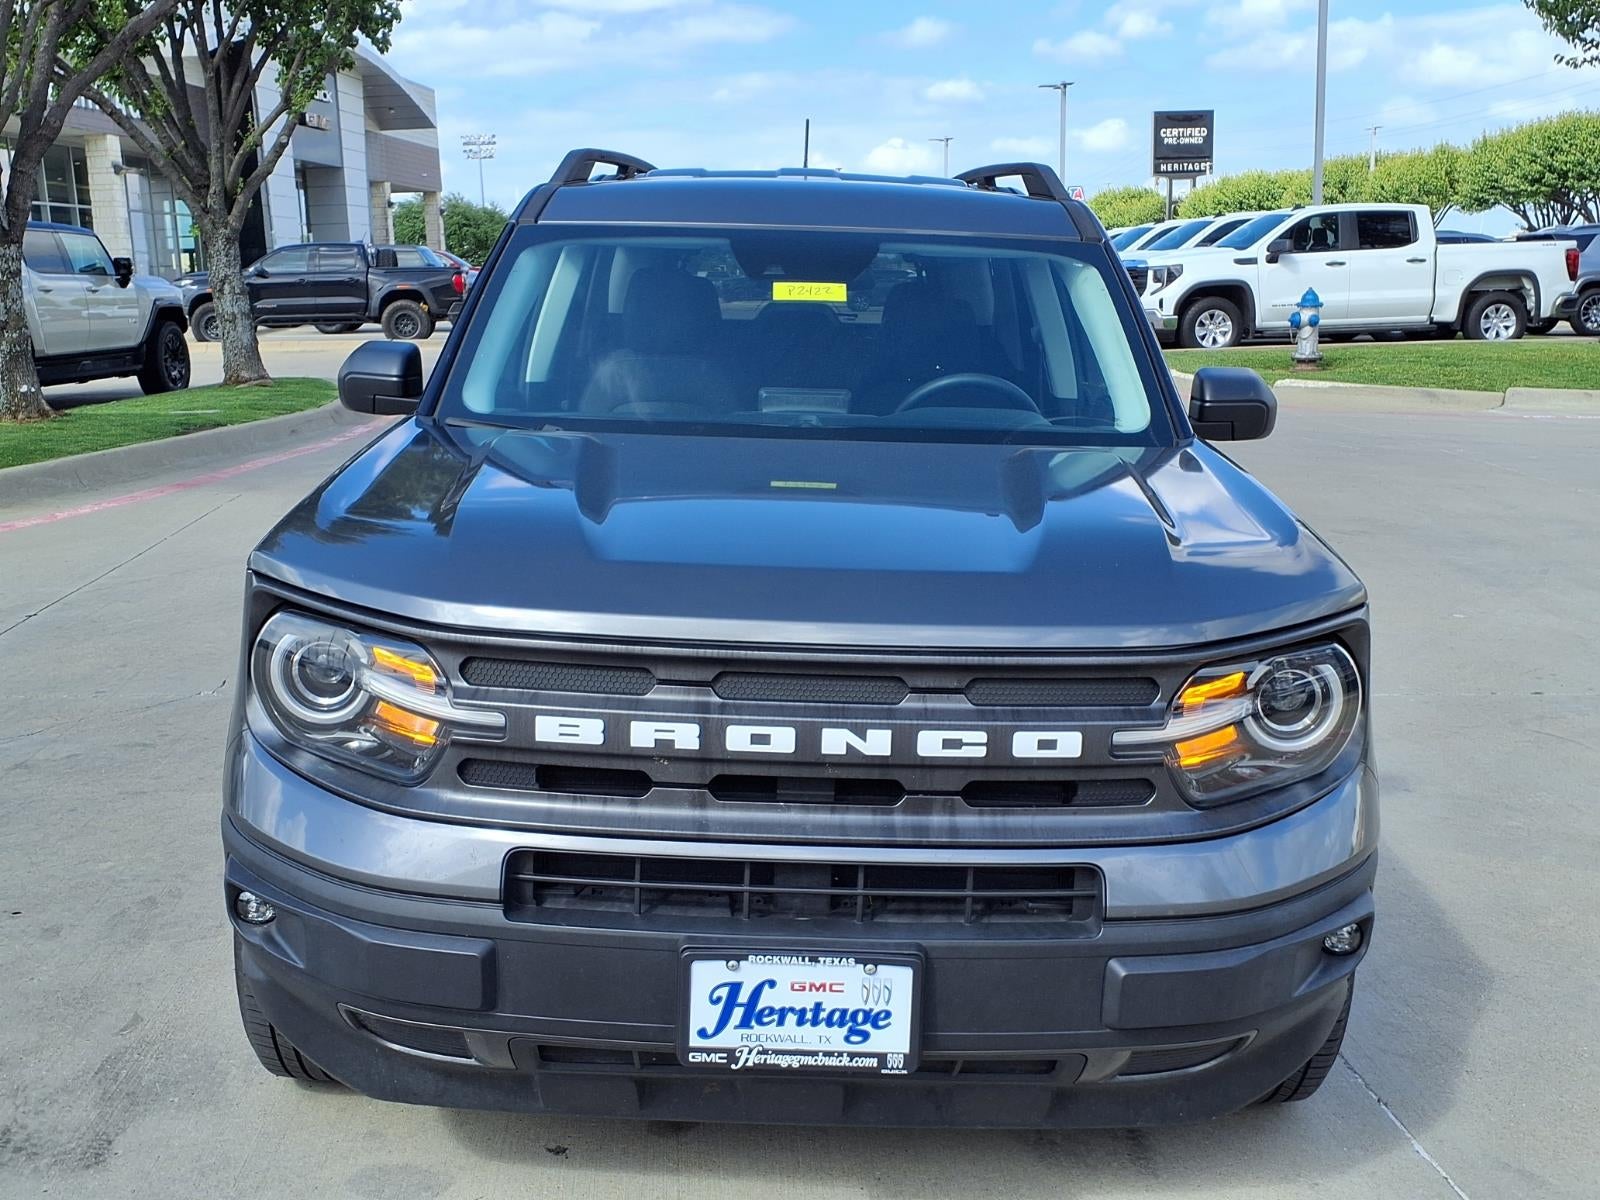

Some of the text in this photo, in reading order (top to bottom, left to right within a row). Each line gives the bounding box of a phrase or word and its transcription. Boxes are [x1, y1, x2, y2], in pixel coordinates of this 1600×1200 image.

[1160, 127, 1208, 138] CERTIFIED
[1163, 137, 1204, 145] PRE-OWNED
[1160, 162, 1206, 172] HERITAGE
[534, 714, 1083, 759] BRONCO
[818, 957, 856, 966] TEXAS
[790, 981, 845, 993] GMC
[696, 978, 893, 1046] Heritage
[816, 1035, 832, 1045] TX
[688, 1045, 878, 1070] GMC Heritagegmcbuick.com
